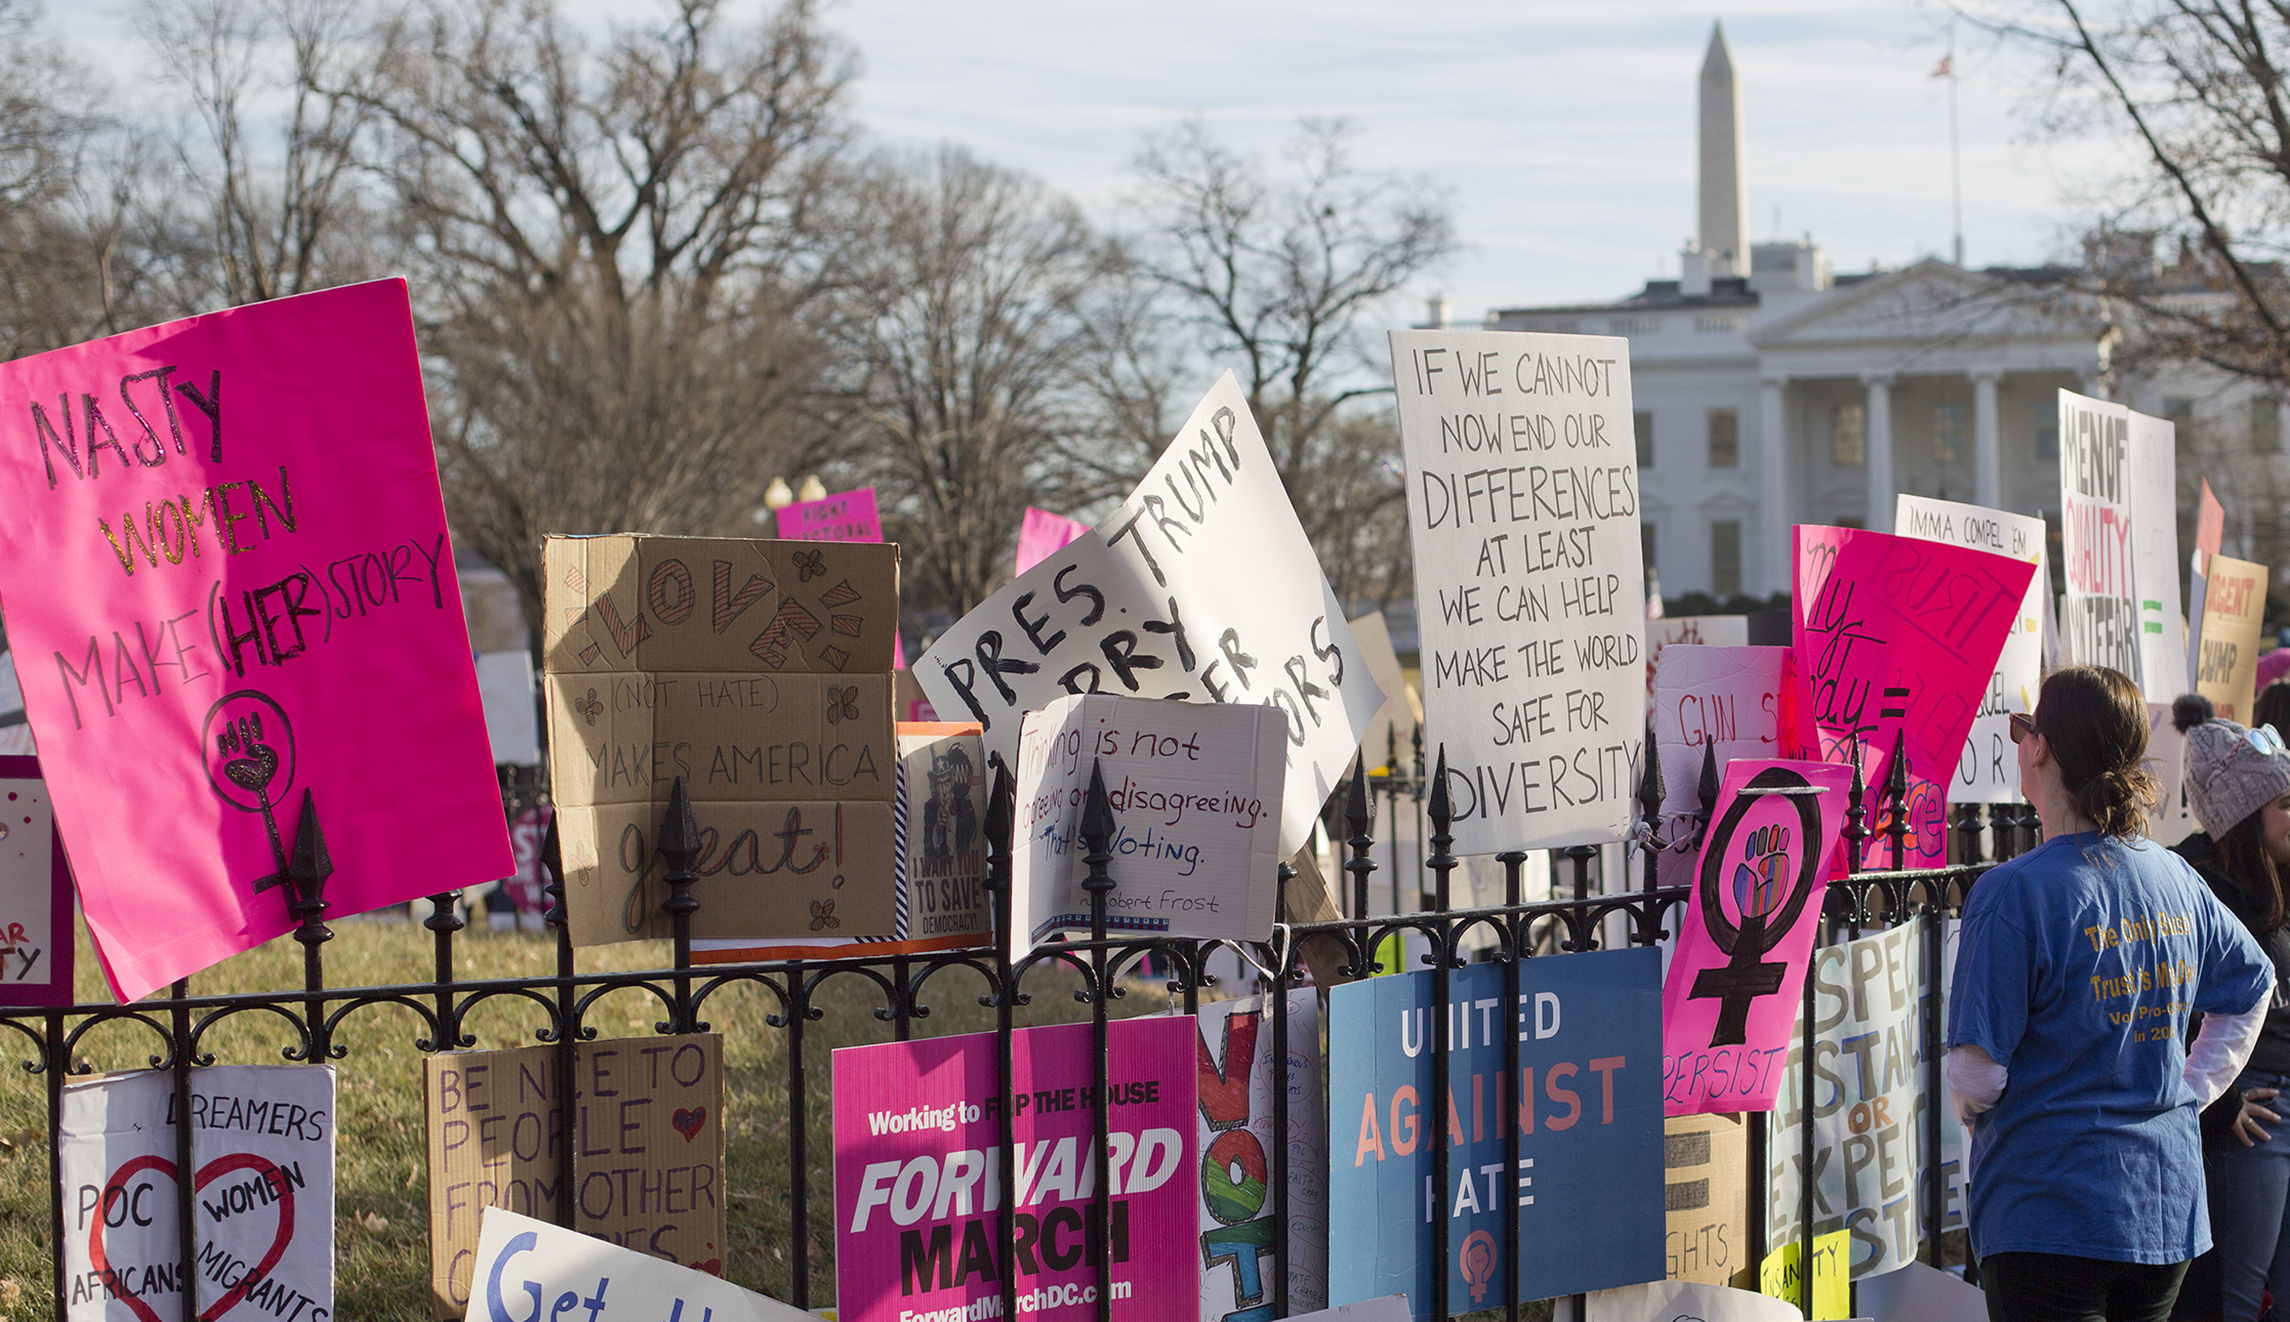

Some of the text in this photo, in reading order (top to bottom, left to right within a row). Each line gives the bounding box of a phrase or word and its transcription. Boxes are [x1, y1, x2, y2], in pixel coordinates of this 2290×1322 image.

[1412, 348, 1616, 398] IF WE CANNOT
[31, 365, 222, 490] NASTY
[1440, 412, 1611, 454] NOW END OUR
[2064, 403, 2106, 498] MEN
[2105, 414, 2129, 506] OF
[98, 465, 297, 576] WOMEN
[1422, 465, 1636, 530] DIFFERENCES
[1909, 504, 1955, 541] IMMA
[1963, 515, 2004, 549] COMPEL
[942, 405, 1241, 733] PRES. TRUMP
[1475, 525, 1596, 577] AT LEAST
[2065, 496, 2131, 599] QUALITY
[594, 558, 824, 670] LOVE
[1439, 573, 1620, 627] WE CAN HELP
[1435, 633, 1639, 689] MAKE THE WORLD
[2094, 595, 2138, 683] FEAR
[614, 674, 780, 714] (NOT HATE)
[1268, 615, 1345, 752] ORS
[1094, 718, 1121, 756] is
[1131, 730, 1201, 761] not
[1492, 688, 1610, 747] SAFE FOR
[1679, 694, 1737, 747] GUN
[585, 741, 880, 789] MAKES AMERICA
[1444, 740, 1642, 823] DIVERSITY
[618, 802, 845, 935] geat!
[921, 855, 953, 878] WANT
[957, 850, 979, 876] YOU
[914, 876, 982, 914] TO SAVE
[923, 913, 978, 935] DEMOCRACY!
[2084, 924, 2120, 952] The
[2121, 913, 2156, 947] Only
[1792, 915, 1932, 1042] SPECT
[2090, 969, 2138, 1002] Trust
[2155, 961, 2176, 995] My
[2134, 1030, 2146, 1043] in
[439, 1043, 706, 1114] BE NIE TO
[1664, 1045, 1786, 1106] PERSIST
[868, 1103, 957, 1137] Working
[957, 1099, 981, 1125] to
[984, 1093, 1031, 1121] FP
[1033, 1087, 1076, 1115] THE
[1354, 1055, 1627, 1168] AGAINST
[1848, 1095, 1894, 1136] OR
[579, 1163, 716, 1220] OTHER
[849, 1126, 1184, 1235] FORWARD
[1771, 1090, 1928, 1235] EXPECT
[78, 1160, 306, 1231] POC WOMEN
[486, 1230, 610, 1322] Get
[899, 1199, 1131, 1298] MARCH
[1665, 1222, 1730, 1280] GHTS
[1762, 1240, 1839, 1299] INSANTY
[899, 1279, 1132, 1322] wardMrchDC.cm
